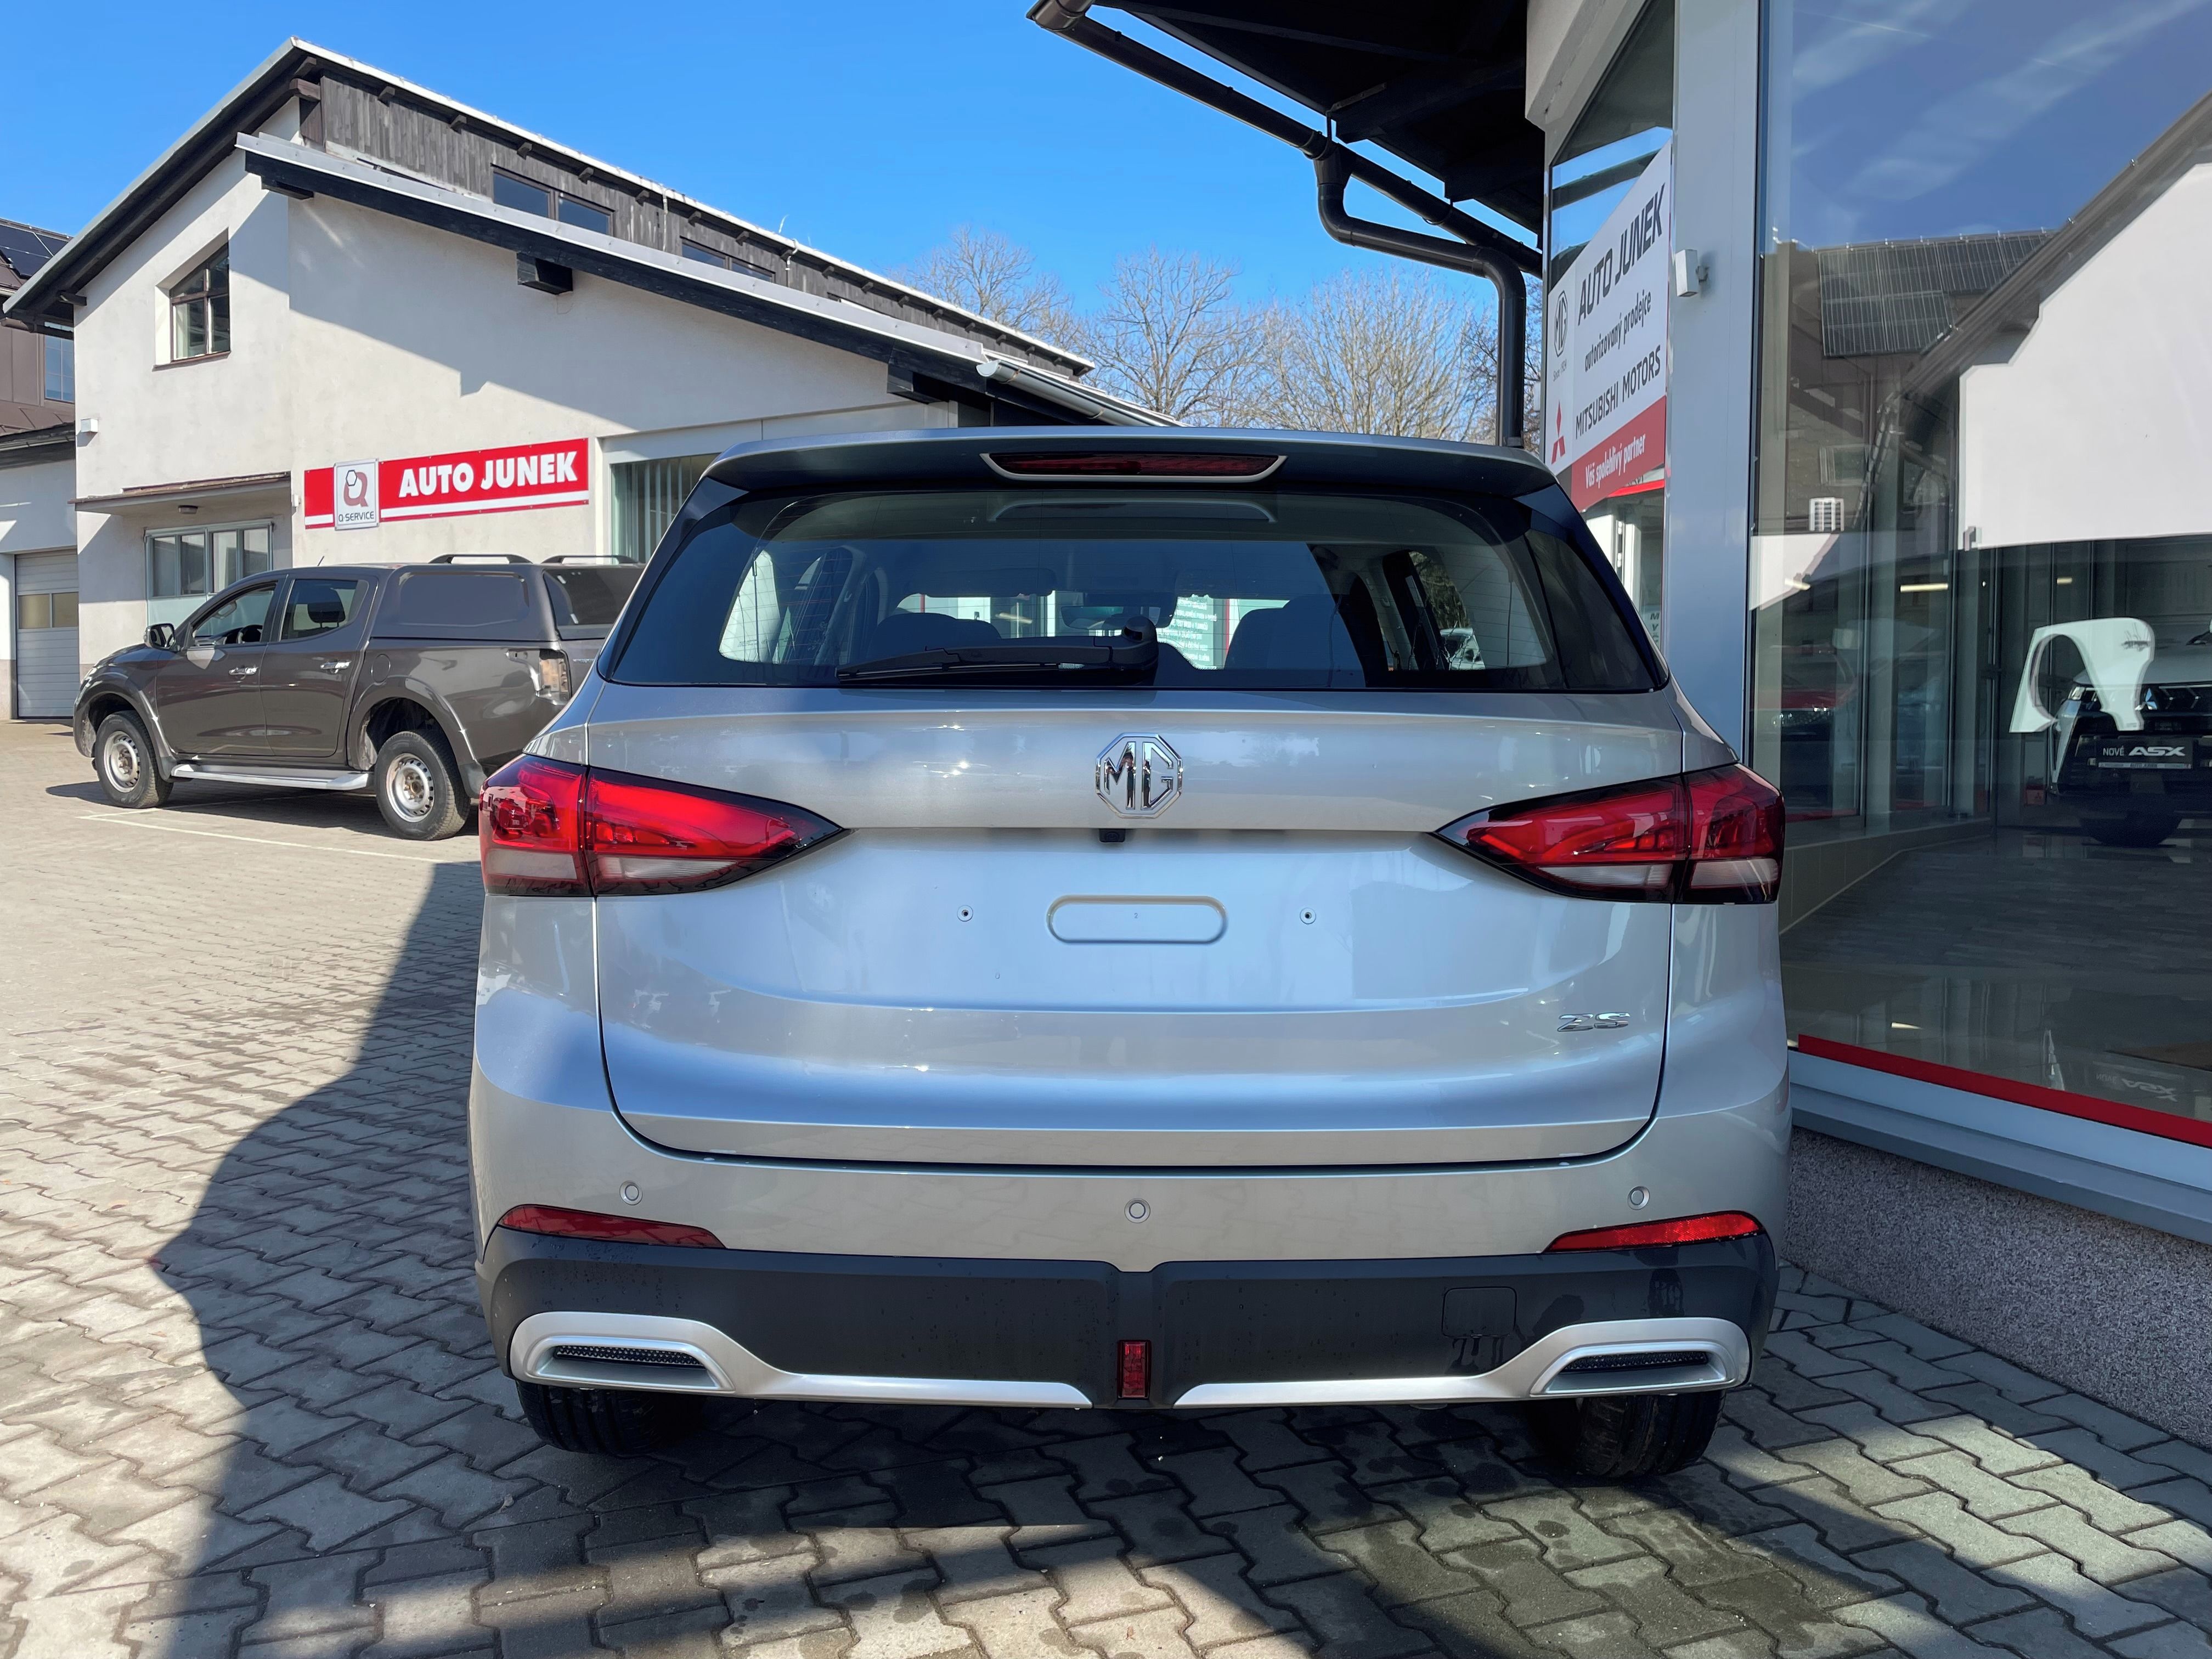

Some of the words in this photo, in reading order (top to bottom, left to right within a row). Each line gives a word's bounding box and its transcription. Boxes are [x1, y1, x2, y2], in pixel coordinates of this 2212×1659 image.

[1578, 248, 1612, 326] AUTO
[1615, 182, 1665, 286] JUNEK
[1555, 296, 1567, 352] MG
[1585, 312, 1622, 373] autorizovaný
[1623, 289, 1651, 345] prodejce
[1576, 381, 1618, 439] MITSUBISHI
[1622, 345, 1660, 402] MOTORS
[398, 462, 474, 498] AUTO
[480, 451, 578, 490] JUNEK
[1585, 462, 1595, 489] Váš
[1596, 443, 1622, 489] spolehlivý
[1623, 433, 1646, 473] partner
[1103, 741, 1173, 811] MG
[2103, 746, 2124, 757] NOVÉ
[2129, 746, 2186, 757] ASX
[1557, 1012, 1630, 1032] ZS
